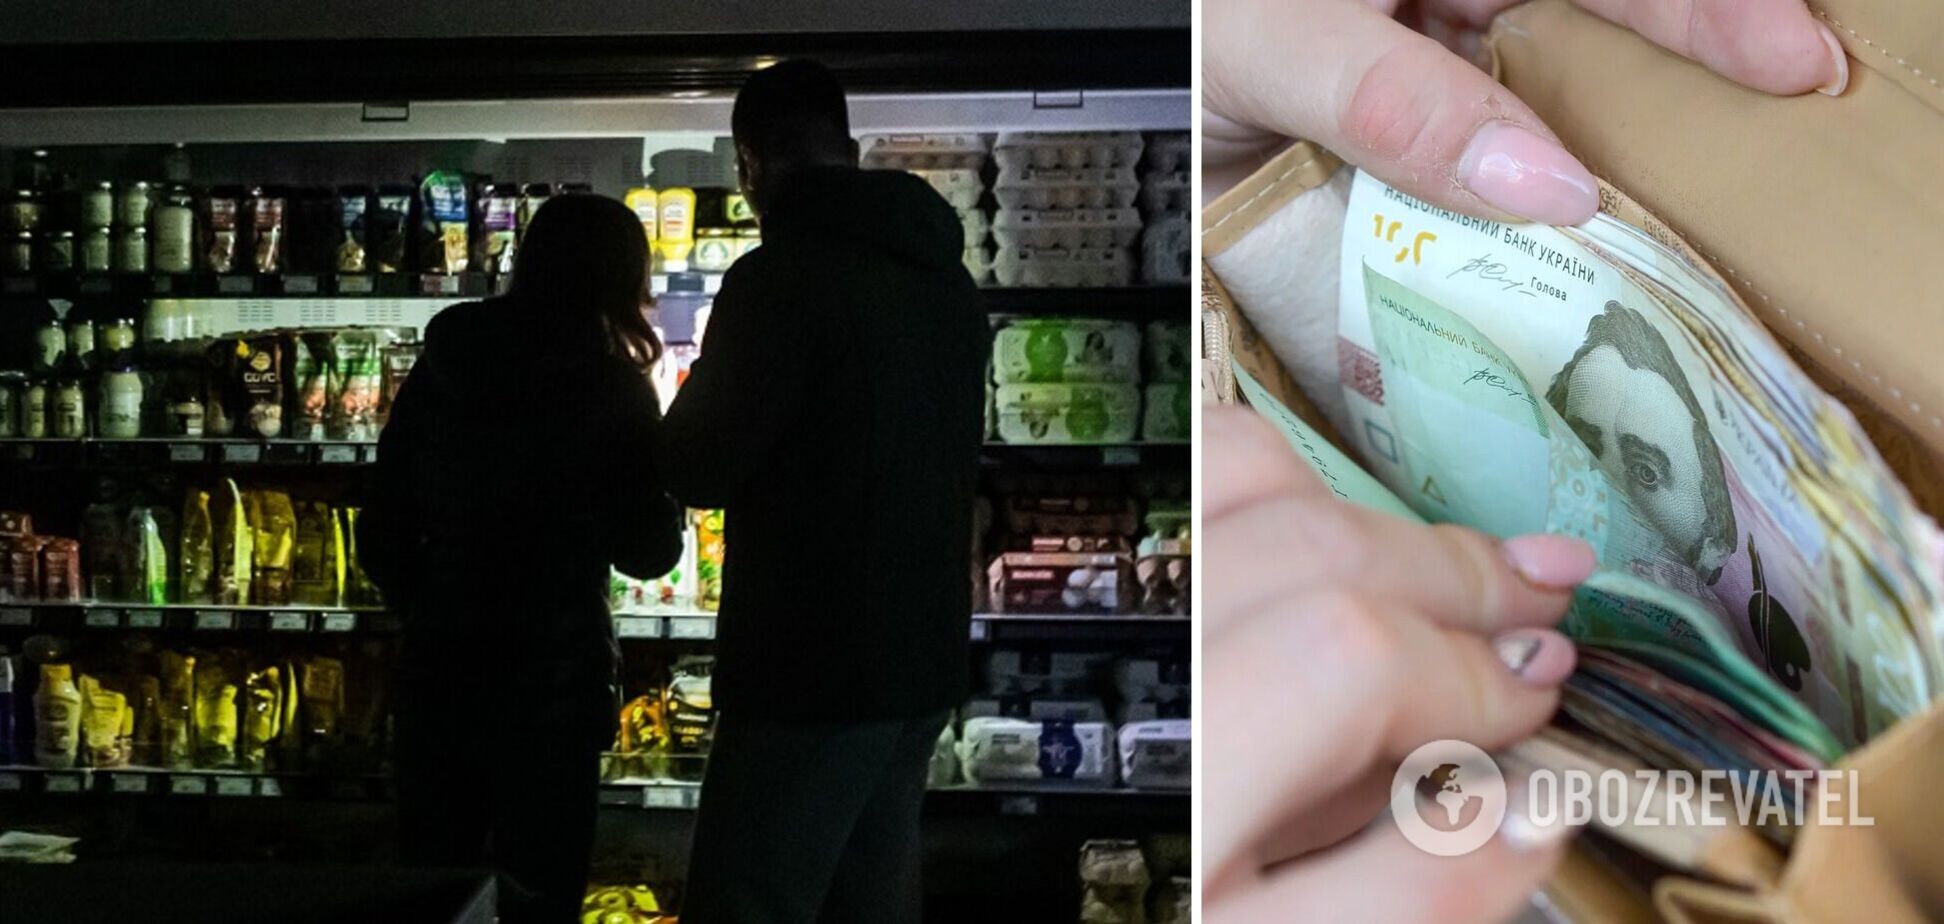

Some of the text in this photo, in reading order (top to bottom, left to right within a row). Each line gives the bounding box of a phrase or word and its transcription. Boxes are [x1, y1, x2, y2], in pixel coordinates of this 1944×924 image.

[1504, 226, 1537, 257] БАНК
[1538, 244, 1595, 286] УКРАЇНИ
[1530, 276, 1567, 301] Голова
